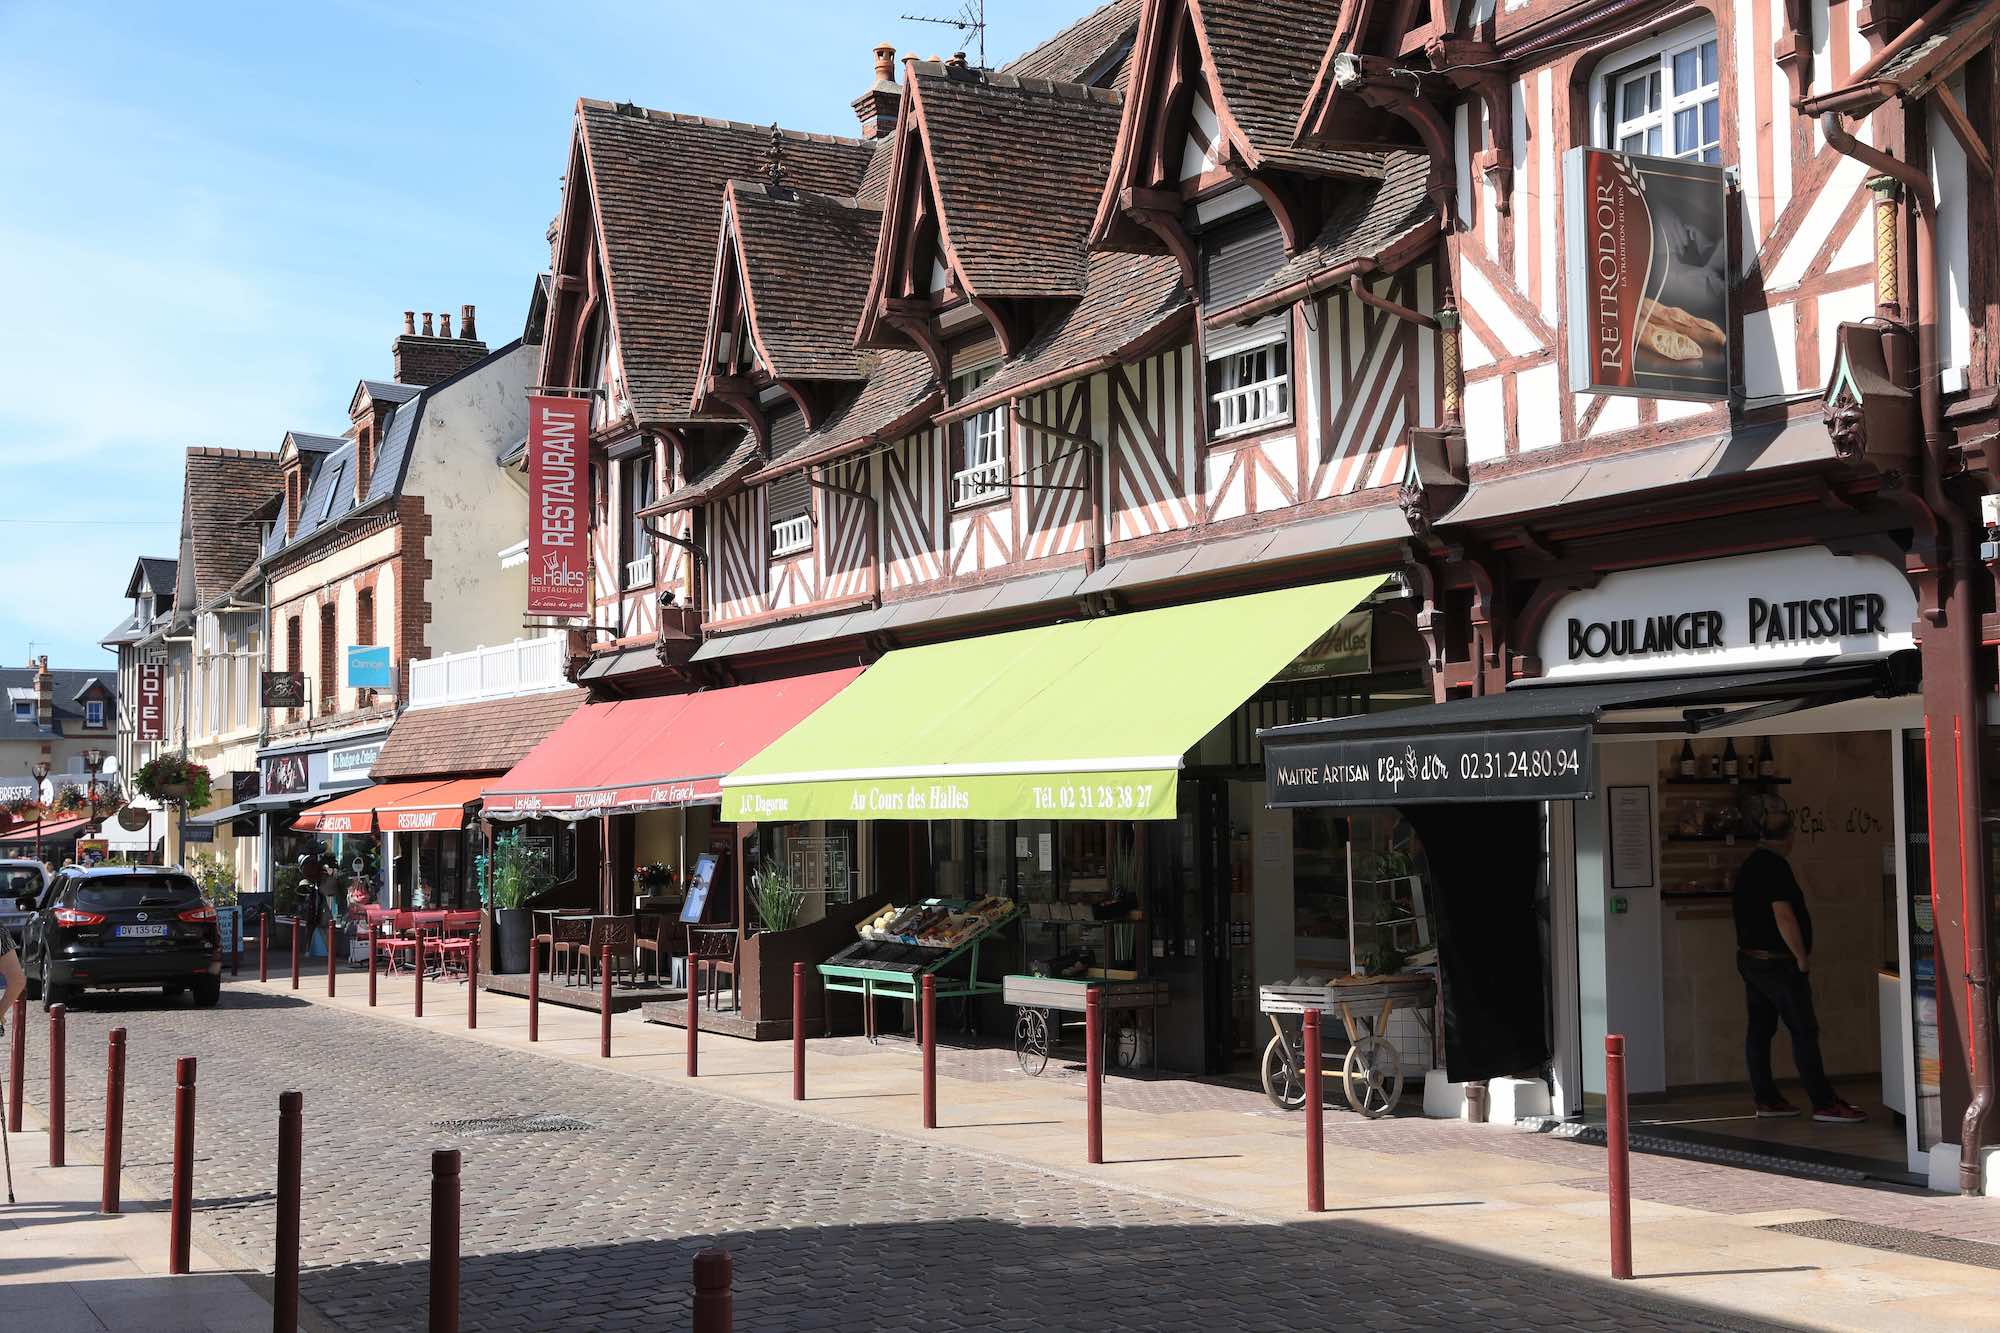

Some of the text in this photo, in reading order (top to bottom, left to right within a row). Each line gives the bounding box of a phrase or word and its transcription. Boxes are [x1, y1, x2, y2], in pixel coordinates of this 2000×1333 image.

[1617, 185, 1628, 288] LA TRADITION DU PAIN
[1596, 179, 1623, 371] RETRODOR
[541, 407, 576, 547] RESTAURANT
[531, 555, 584, 587] les Halles
[530, 586, 584, 594] RESTAURANT
[1567, 593, 1886, 661] BOULANGER PATISSIER
[142, 664, 160, 733] HOTEL
[1275, 748, 1581, 794] MAITRE ARTISAN l'Epi d'Or 02.31.24.80.94
[523, 797, 542, 810] Halles
[575, 791, 618, 809] RESTAURANT
[650, 784, 696, 803] Chez Franck
[850, 783, 970, 811] Au Cours des Halles
[1032, 784, 1153, 810] Tél. 02 31 28 38 27
[398, 812, 438, 829] RESTAURANT
